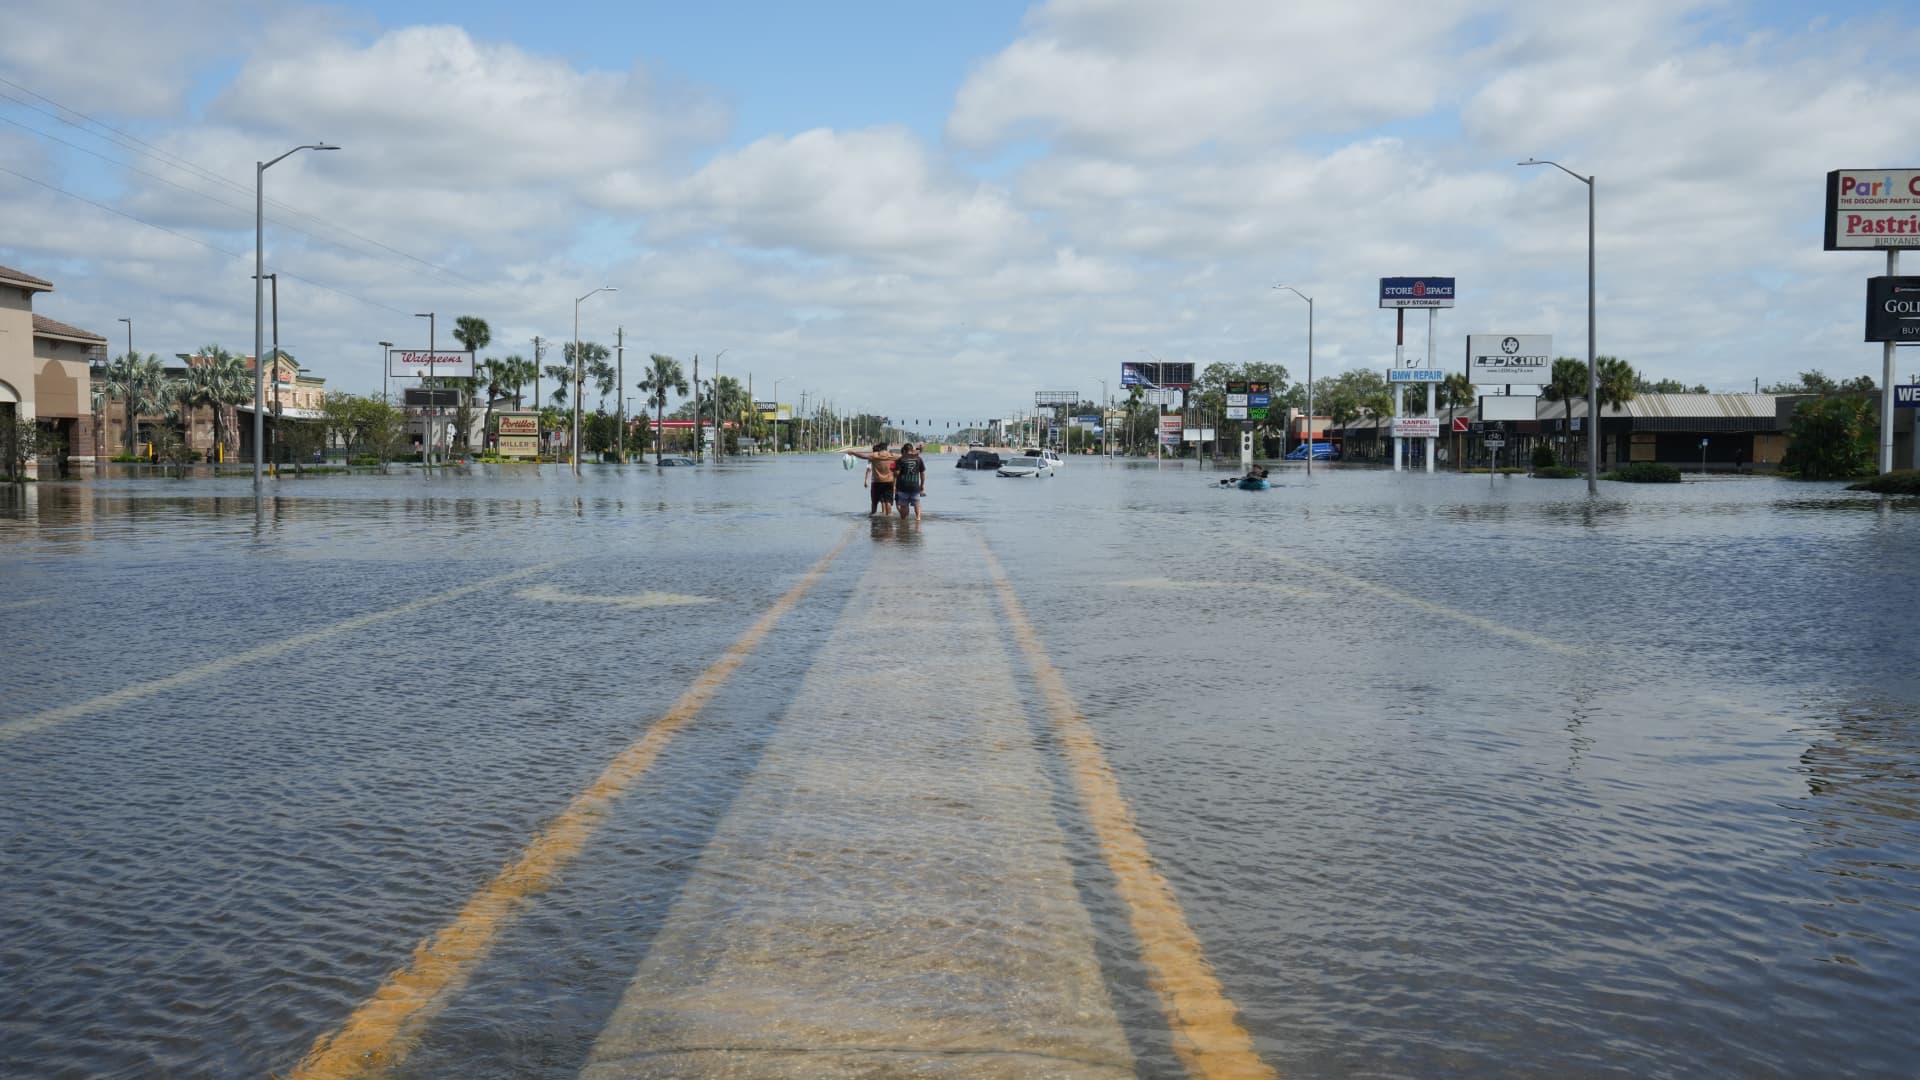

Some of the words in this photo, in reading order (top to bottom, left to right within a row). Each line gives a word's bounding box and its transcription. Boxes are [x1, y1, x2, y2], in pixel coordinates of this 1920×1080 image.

[1847, 214, 1920, 234] Pastri
[1385, 287, 1413, 295] STORE
[1426, 287, 1453, 295] SPACE
[1392, 370, 1411, 380] BMW
[1414, 370, 1442, 380] REPAIR
